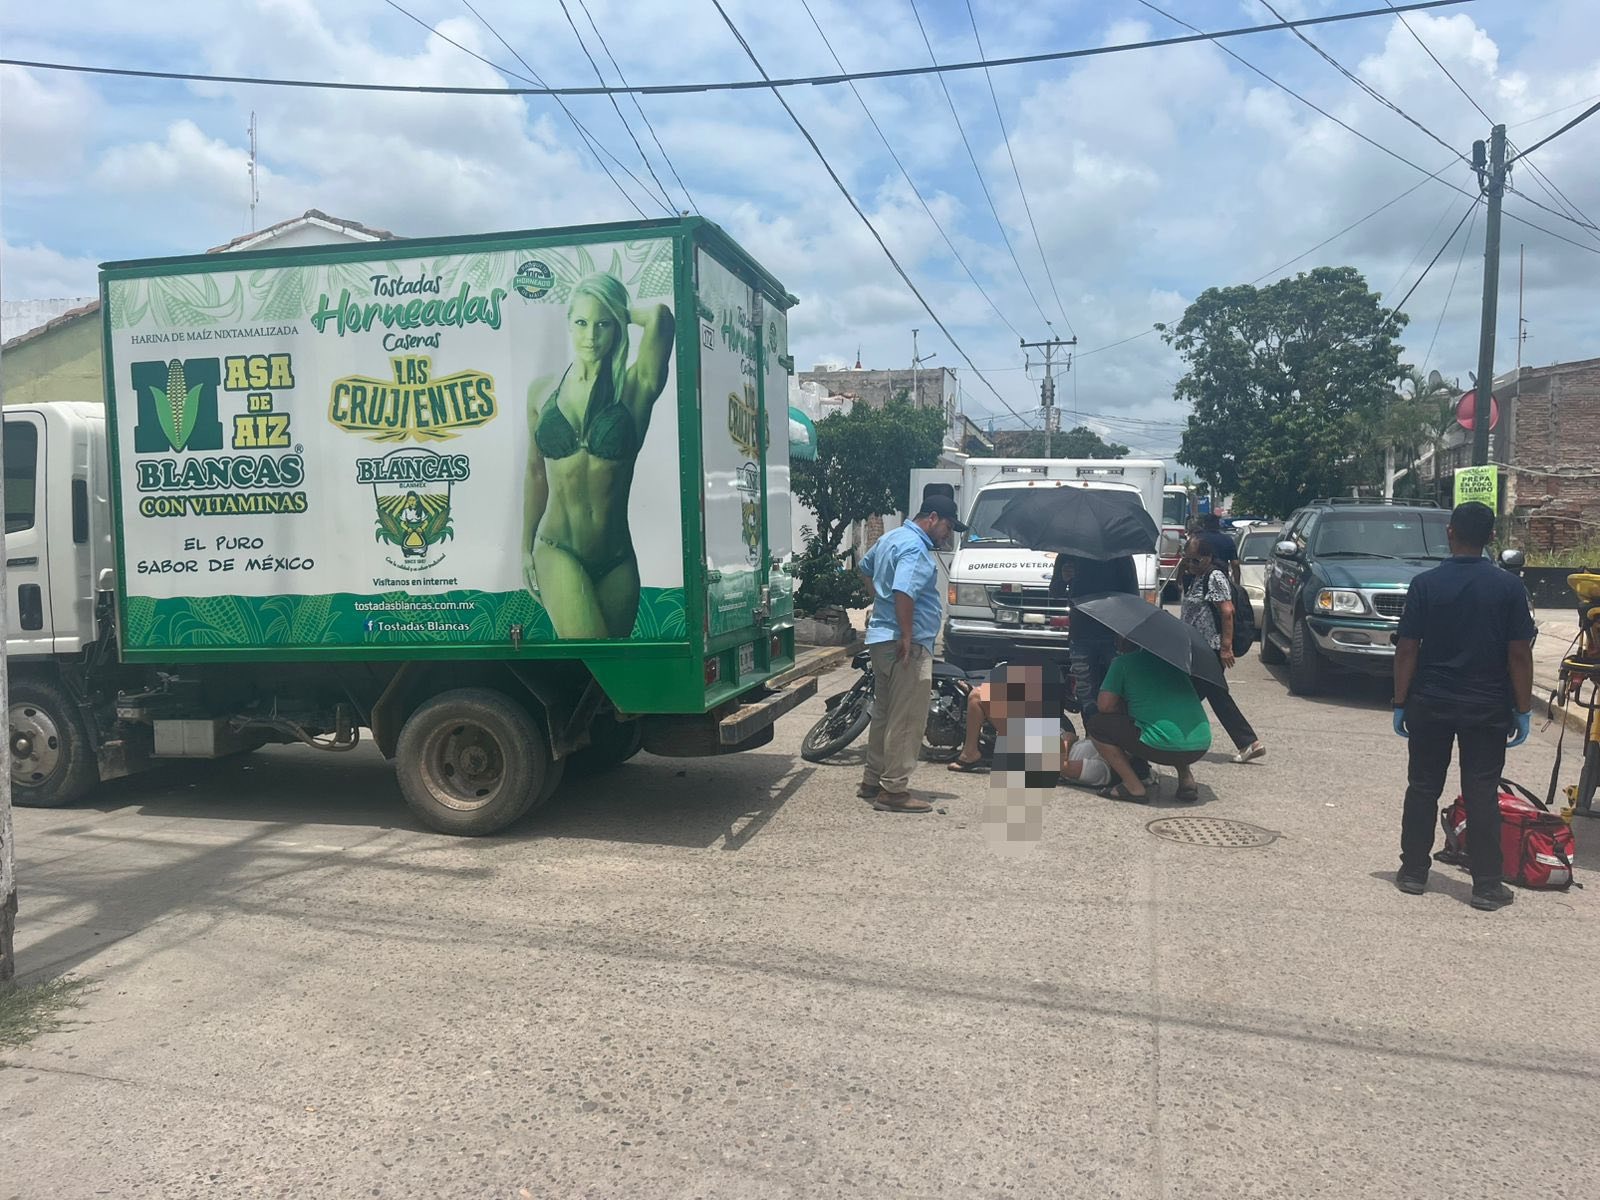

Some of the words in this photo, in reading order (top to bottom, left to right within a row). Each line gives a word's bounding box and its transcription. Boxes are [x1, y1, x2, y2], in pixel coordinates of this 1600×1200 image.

[369, 273, 443, 297] Tostadas
[311, 281, 507, 337] Horneadas
[131, 333, 170, 345] HARINA
[171, 332, 185, 342] DE
[187, 329, 213, 341] MAÍZ
[214, 326, 299, 340] NIXTAMALIZADA
[382, 332, 441, 351] Caseras
[393, 358, 428, 385] LAS
[247, 392, 273, 413] DE
[332, 377, 494, 429] CRUJIENTES
[136, 454, 305, 491] BLANCAS
[356, 454, 470, 484] BLANCAS
[139, 496, 187, 518] CON
[188, 491, 308, 516] VITAMINAS
[183, 538, 206, 550] EL
[216, 536, 264, 550] PURO
[137, 559, 199, 575] SABOR
[208, 558, 235, 572] DE
[245, 554, 315, 572] MÉXICO
[968, 561, 1018, 571] BOMBEROS
[423, 577, 458, 585] internet
[354, 600, 475, 611] tostadasblancas.com.mx
[378, 621, 425, 631] Tostadas
[427, 621, 470, 631] Blancas
